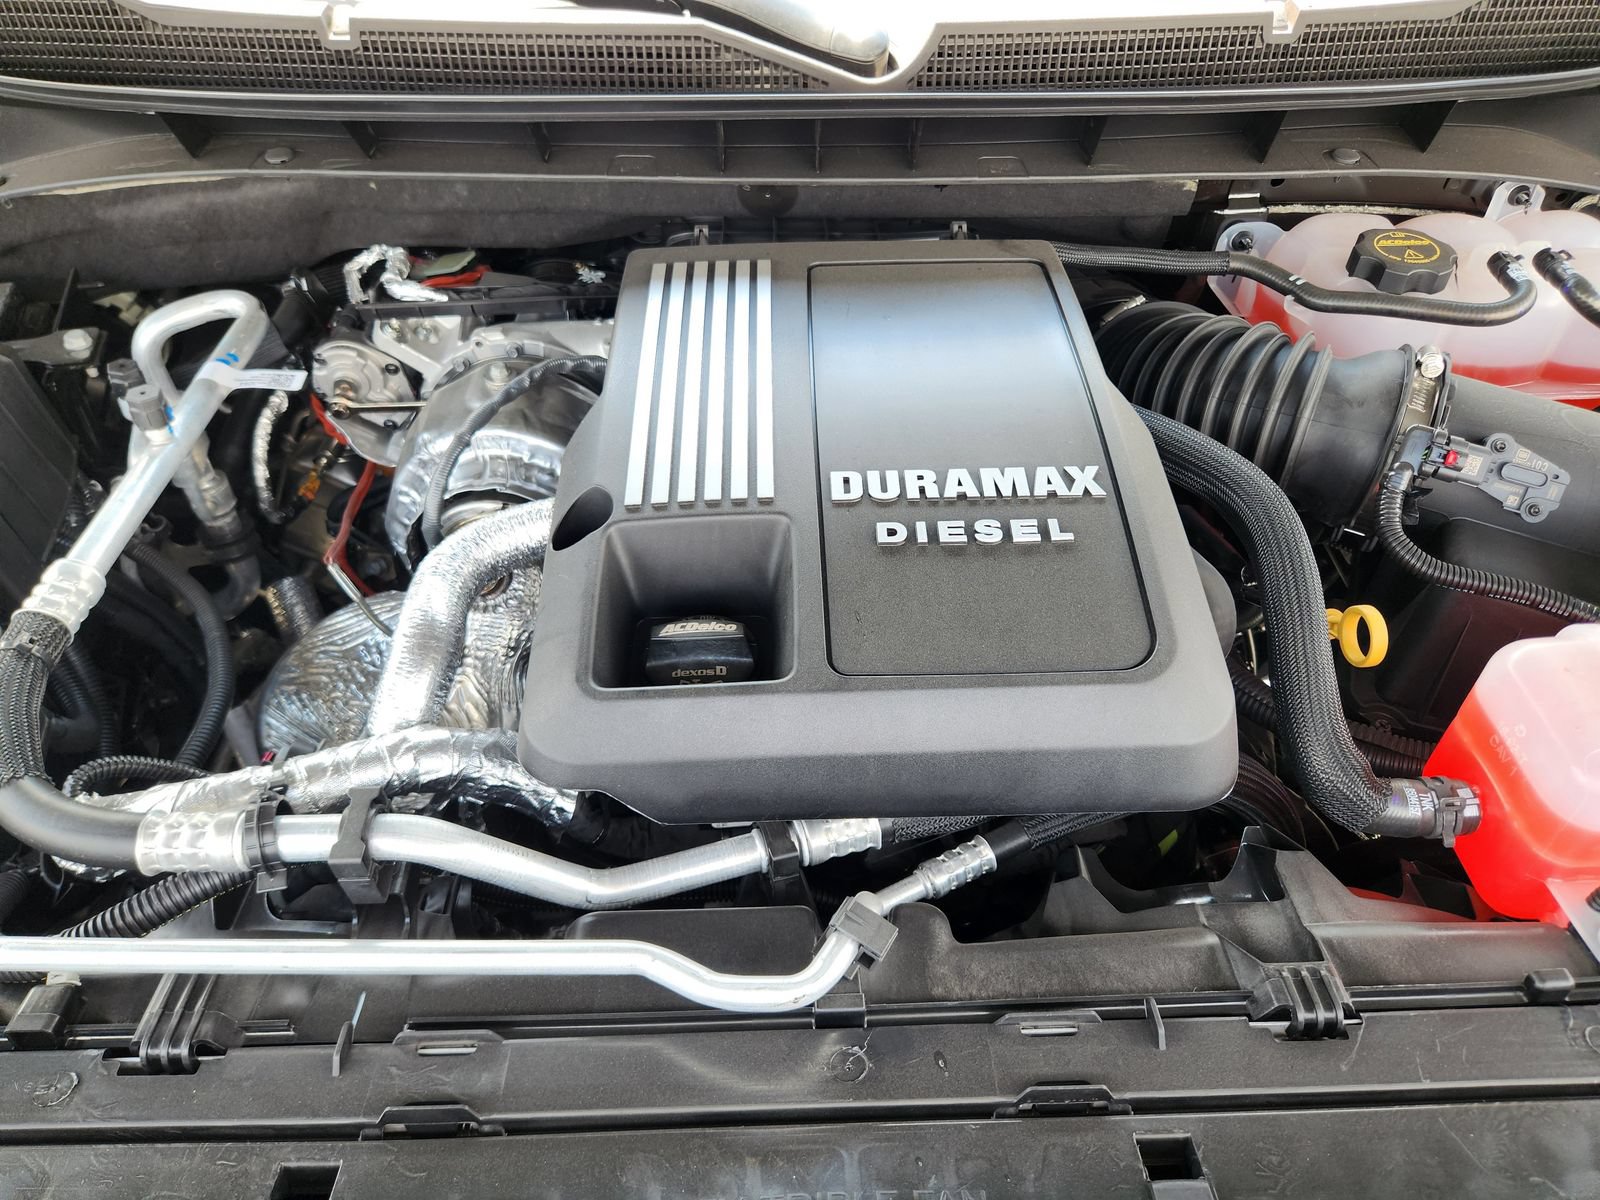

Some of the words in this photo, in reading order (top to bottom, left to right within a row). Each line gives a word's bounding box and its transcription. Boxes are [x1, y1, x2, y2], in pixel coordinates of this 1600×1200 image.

[829, 465, 1107, 503] DURAMAX
[876, 519, 1075, 546] DIESEL
[659, 621, 738, 635] ACDelco
